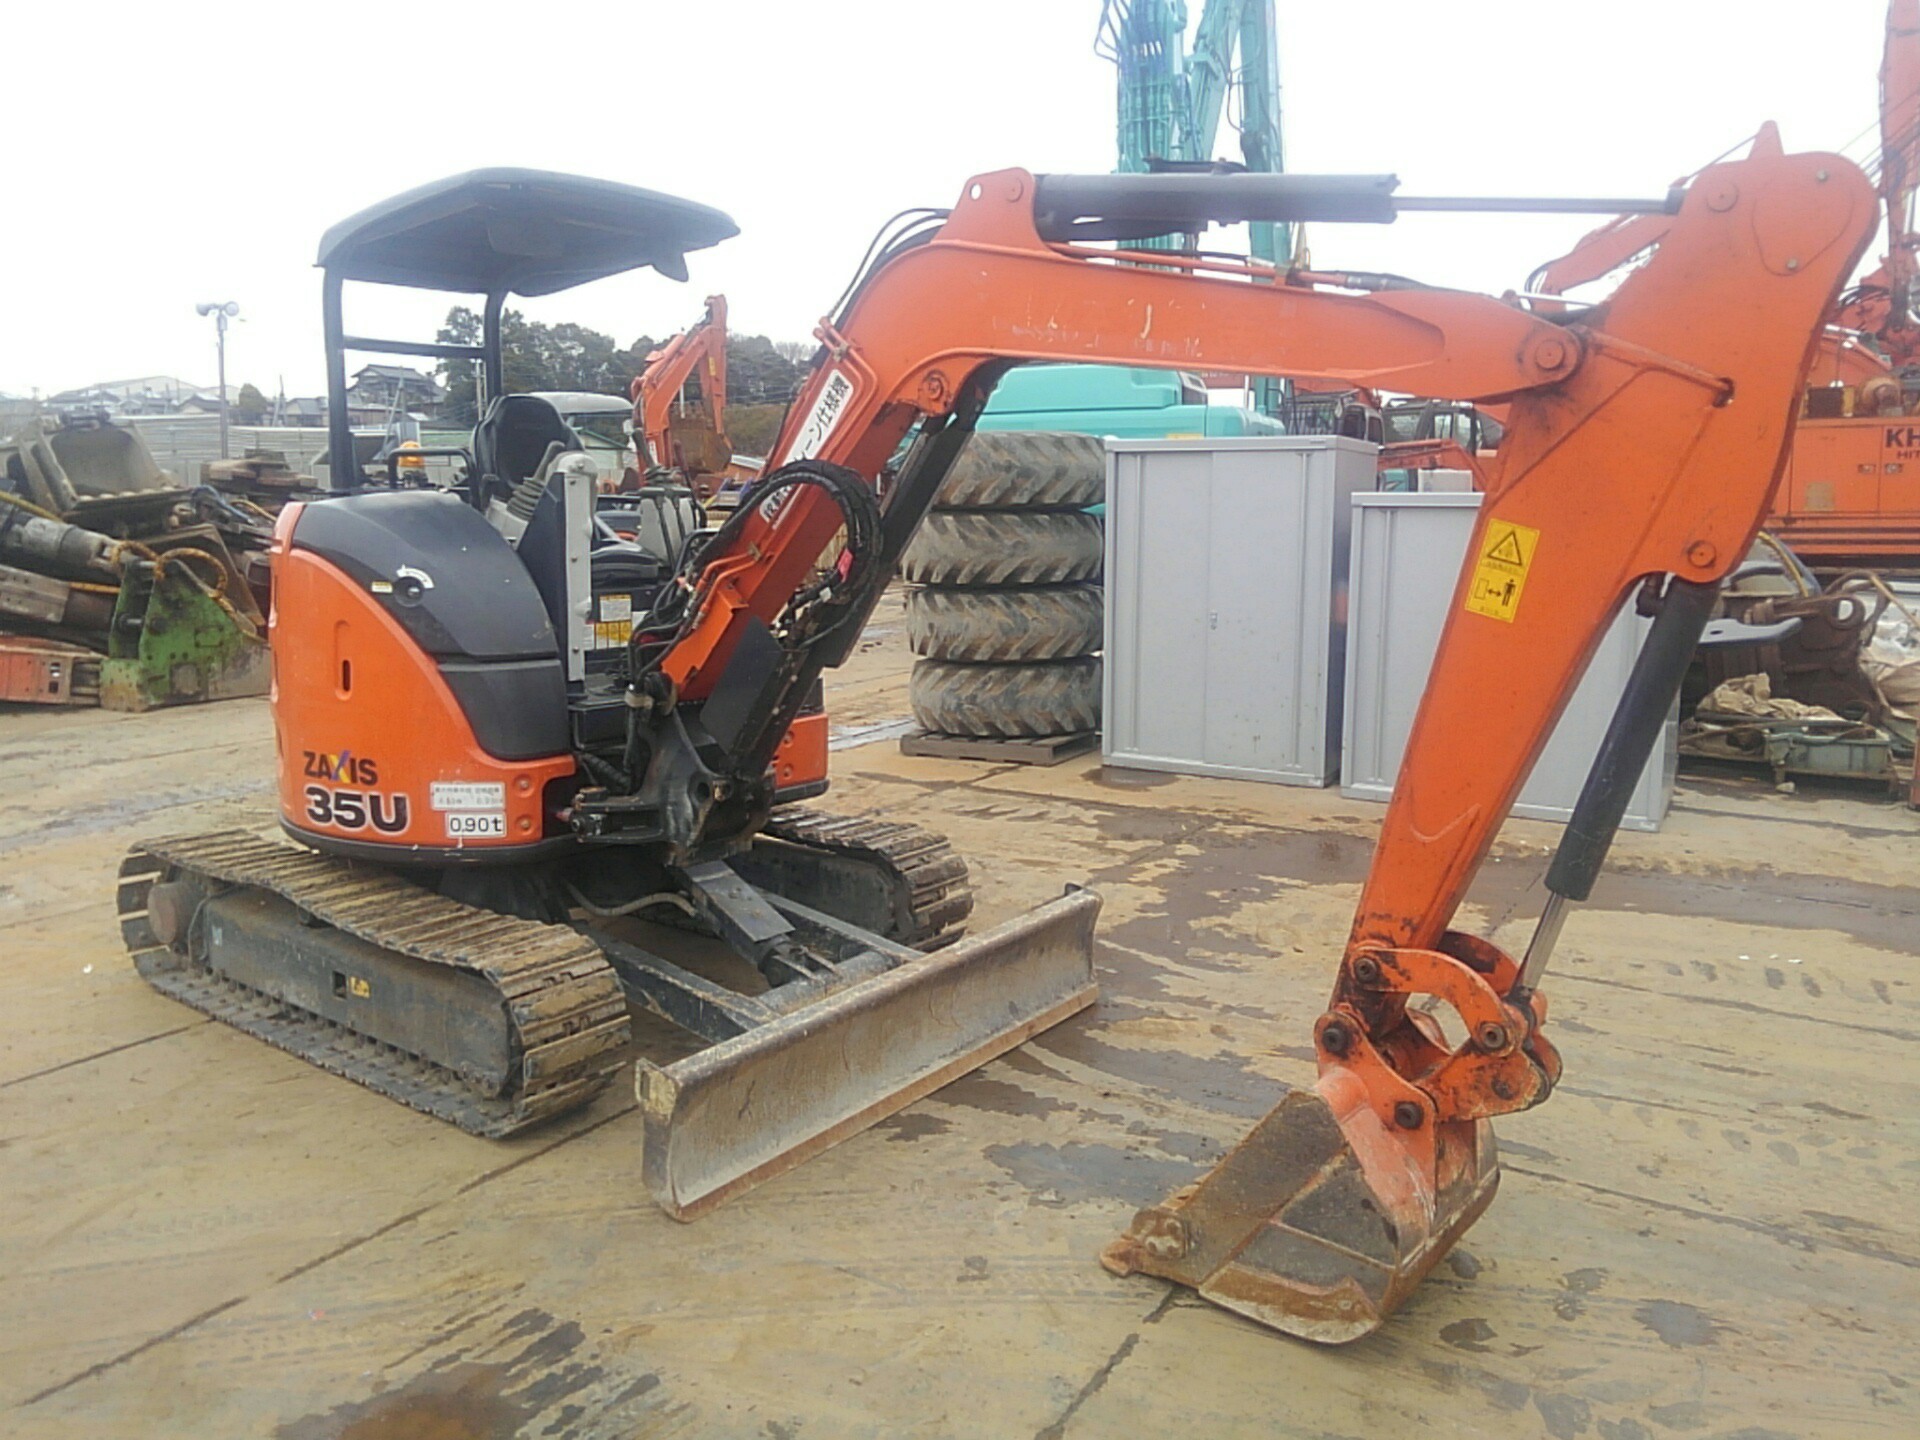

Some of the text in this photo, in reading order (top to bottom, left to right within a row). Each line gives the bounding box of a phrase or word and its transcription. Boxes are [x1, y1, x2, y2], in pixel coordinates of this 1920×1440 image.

[763, 375, 849, 520] 移動ーン仕様機
[303, 750, 378, 785] ZAXIS
[305, 785, 408, 832] 35U
